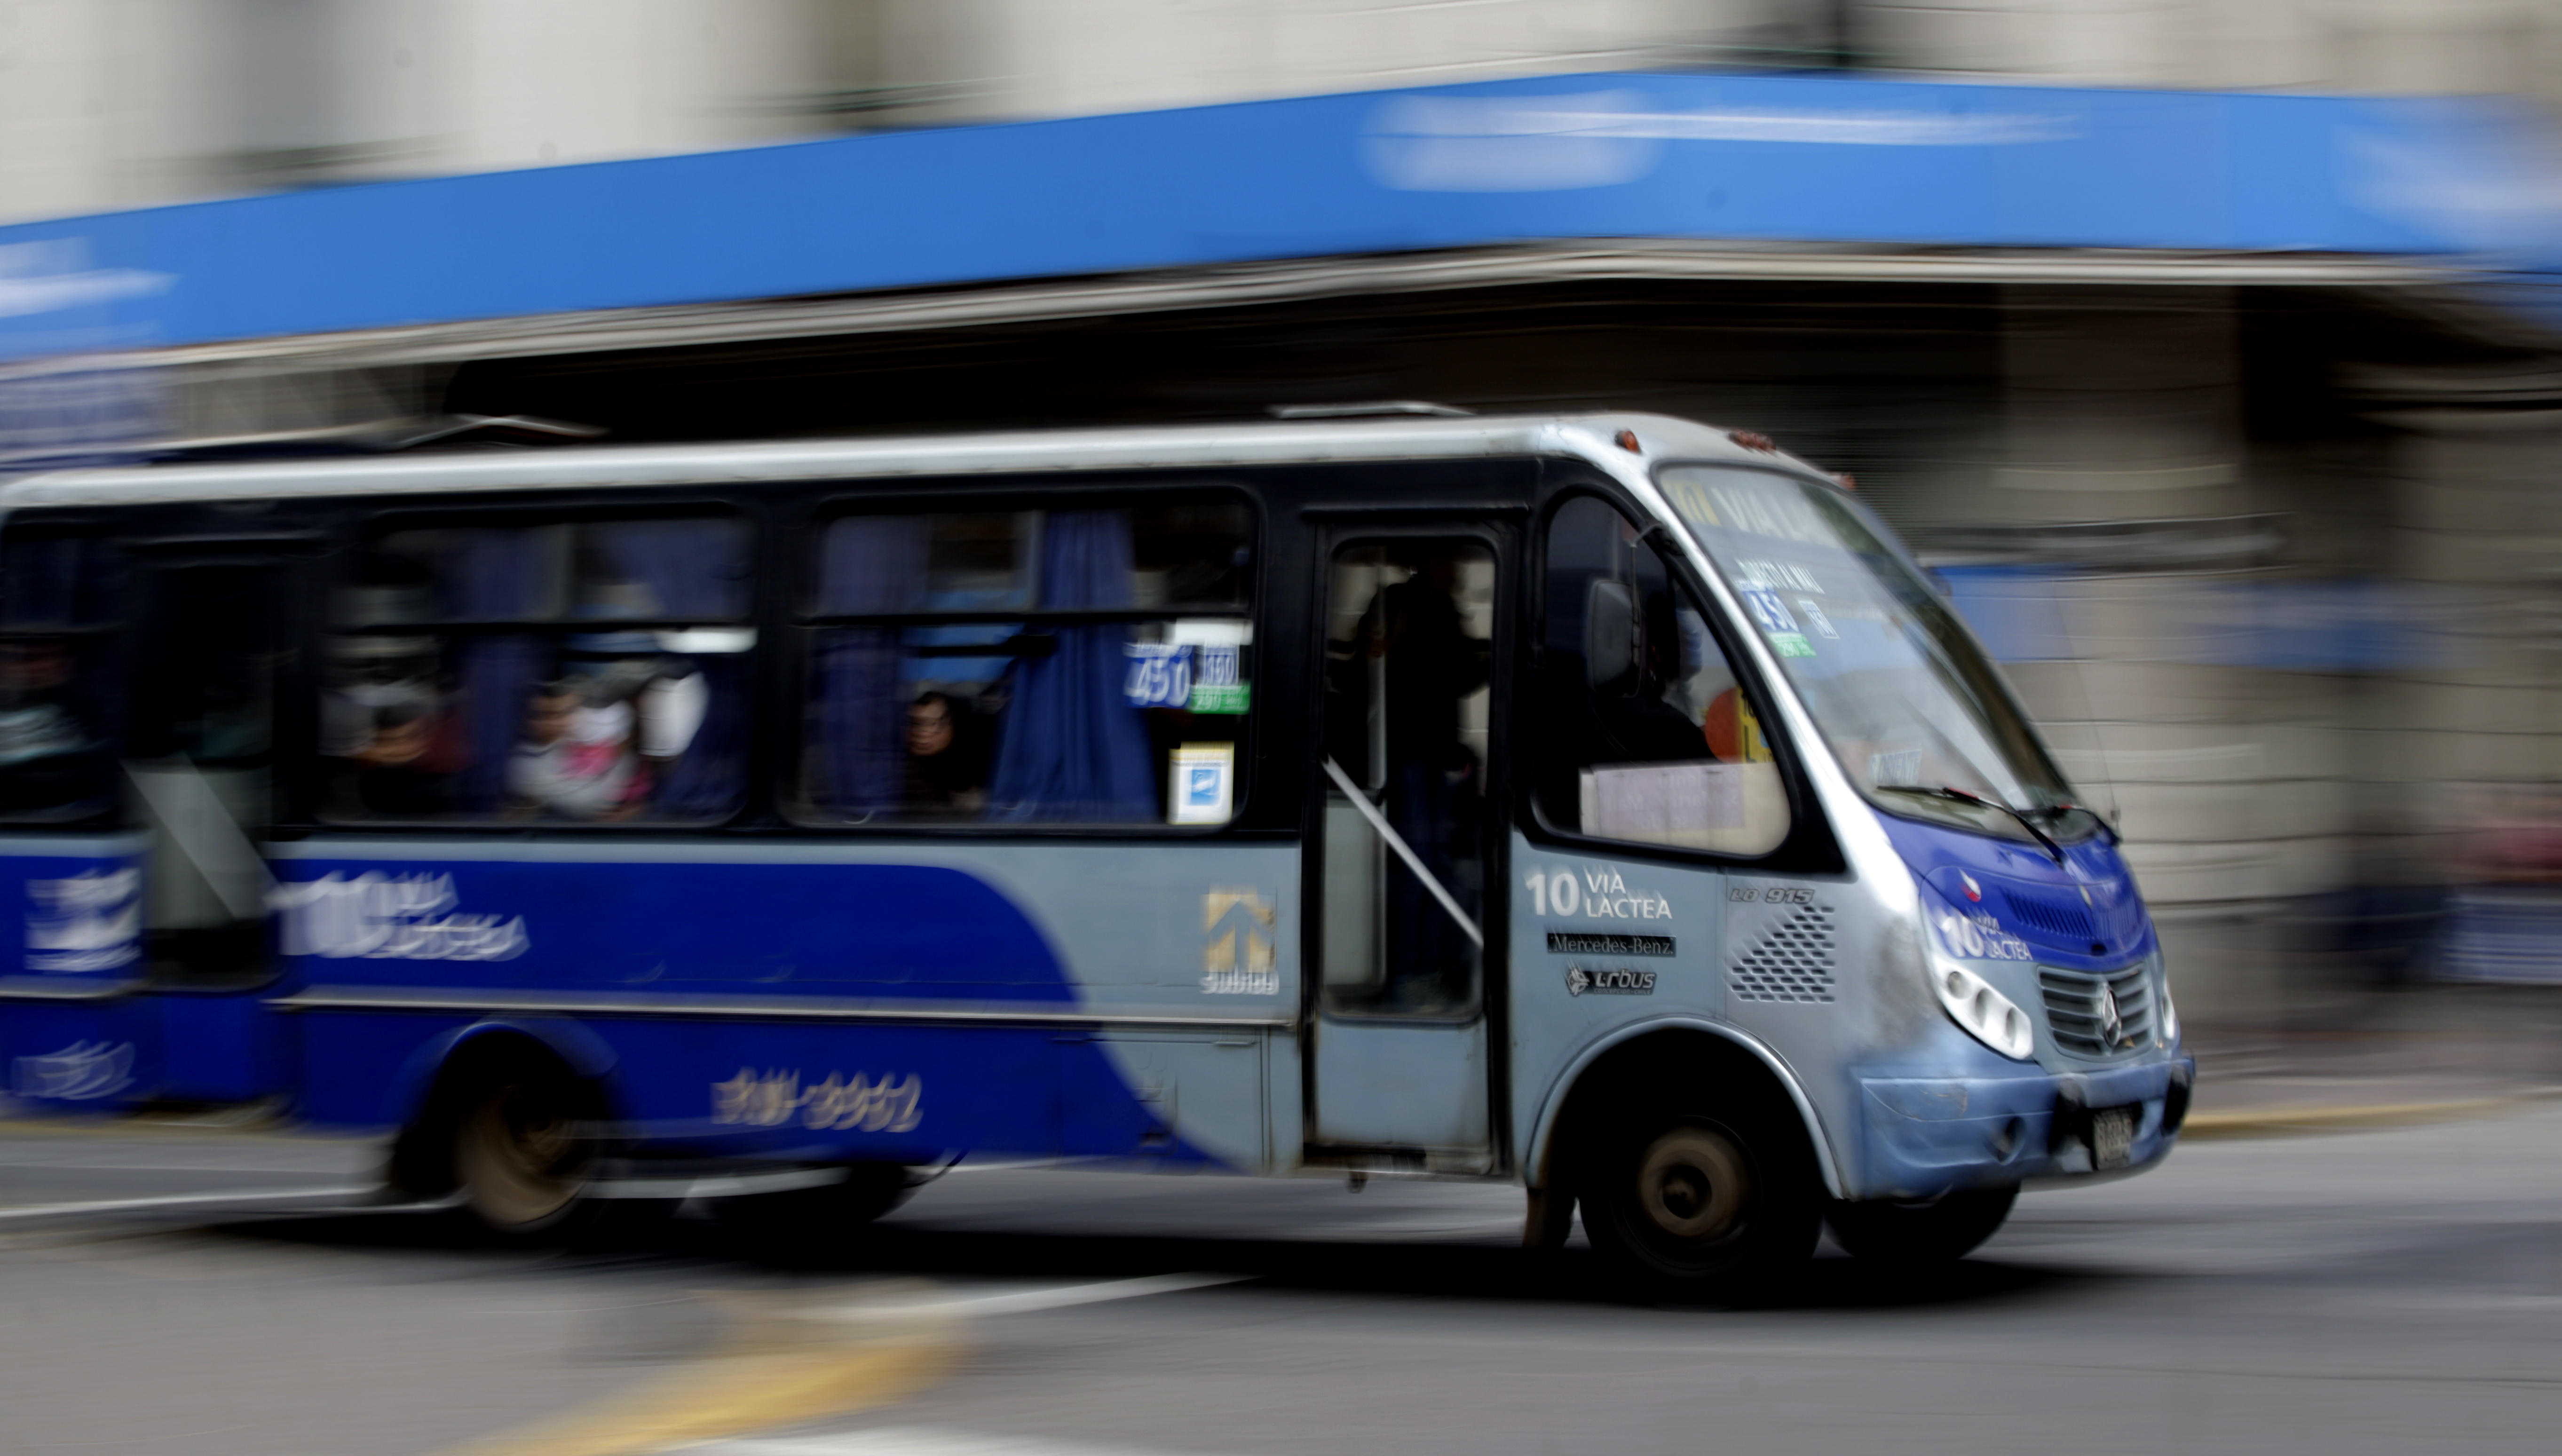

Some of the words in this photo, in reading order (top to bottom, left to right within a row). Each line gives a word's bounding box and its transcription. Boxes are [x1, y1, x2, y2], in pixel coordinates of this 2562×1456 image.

[1748, 592, 1800, 632] 450
[1125, 656, 1191, 707] 450
[1525, 872, 1581, 917] 10
[1586, 873, 1627, 894] VIA
[1586, 897, 1673, 919] LACTEA
[1729, 888, 1760, 902] LO
[1764, 887, 1816, 904] 915
[1554, 935, 1671, 956] Mercedes-Benz
[1938, 915, 1985, 958] 10
[1983, 938, 2034, 961] LACTEA
